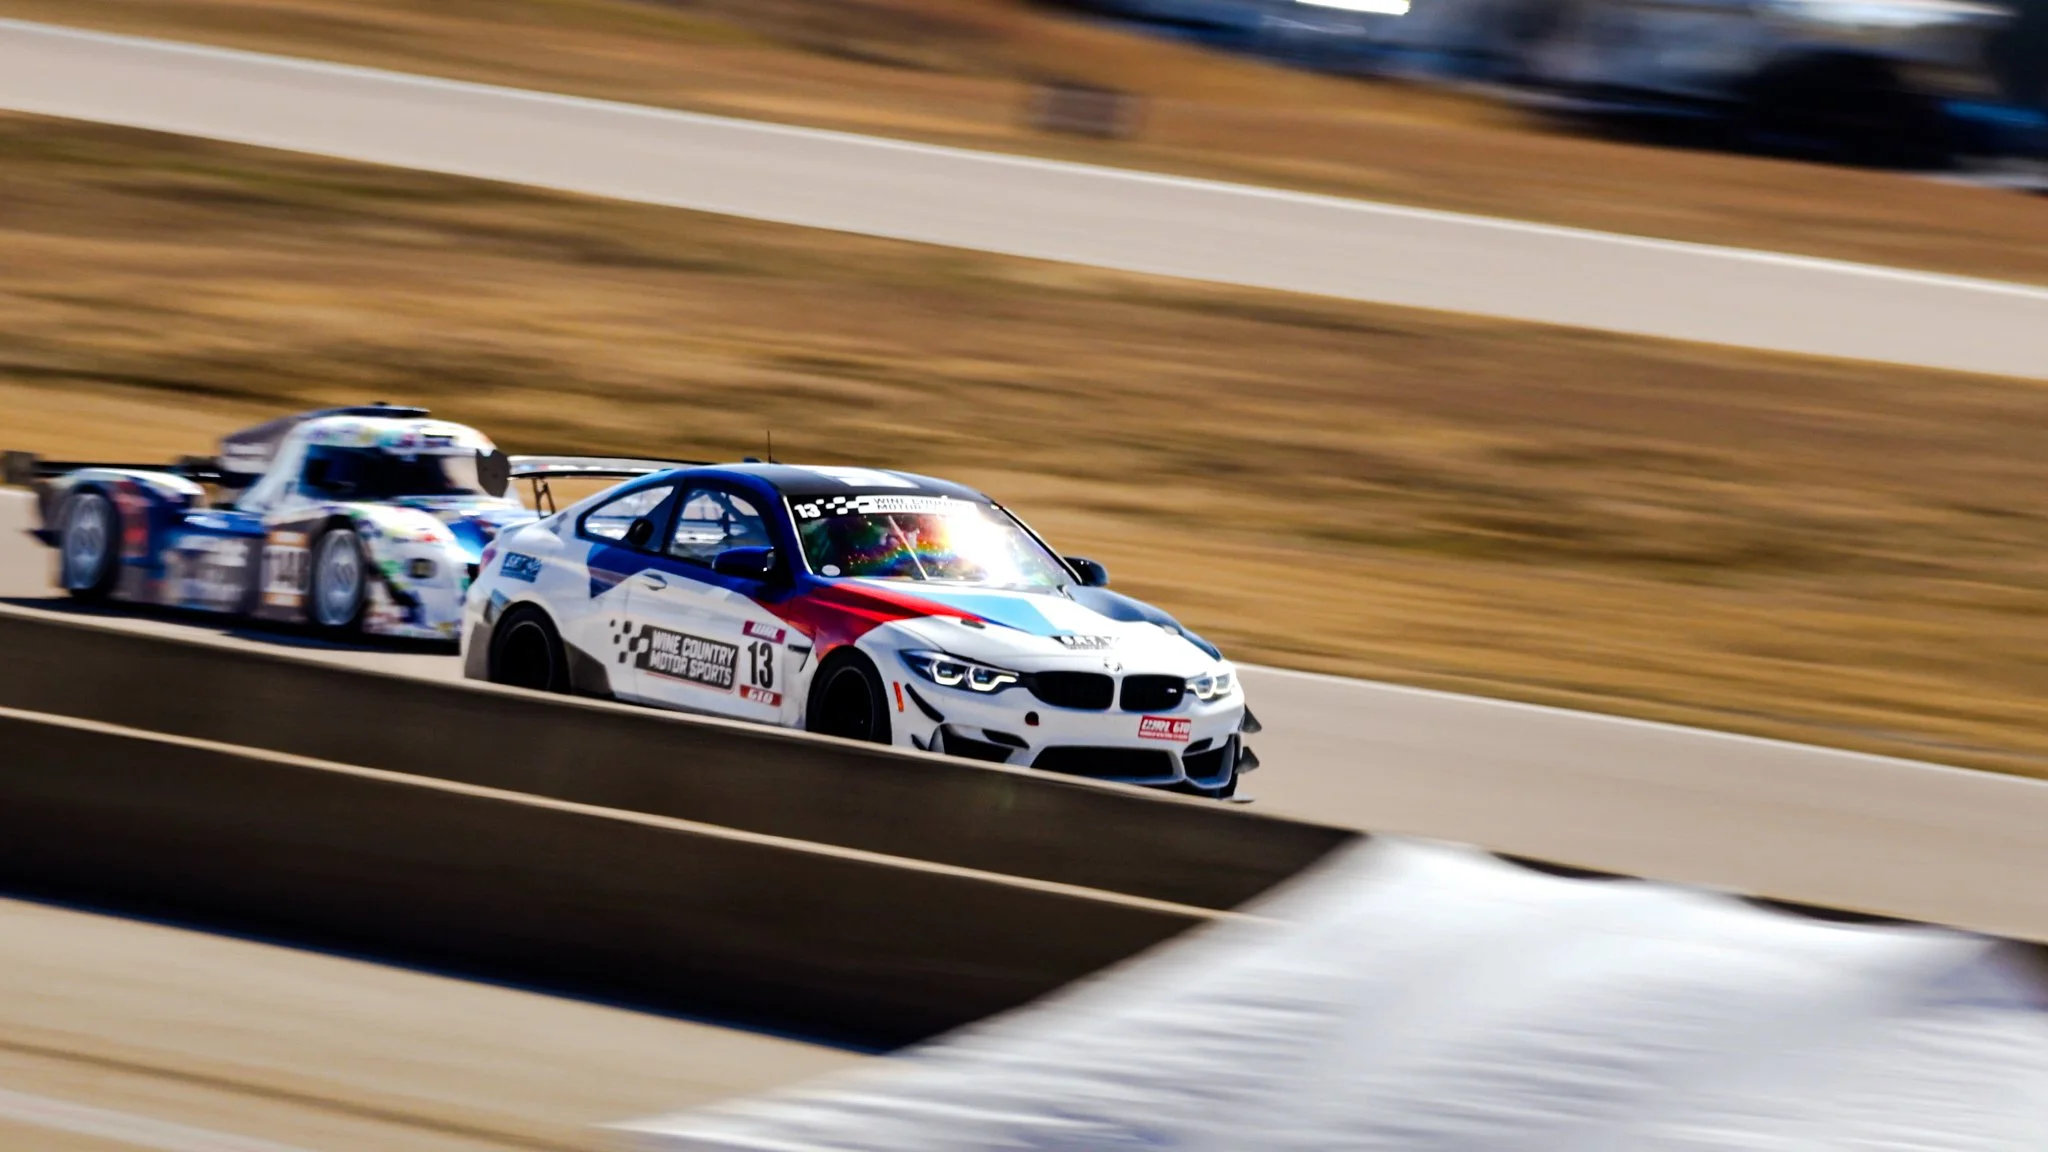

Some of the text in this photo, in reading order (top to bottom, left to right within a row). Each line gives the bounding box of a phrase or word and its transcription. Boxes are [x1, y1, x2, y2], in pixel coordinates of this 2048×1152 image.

[794, 502, 821, 519] 13
[652, 629, 735, 667] WINE COUNTRY
[747, 641, 774, 689] 13
[649, 650, 732, 686] MOTOR SPORTS
